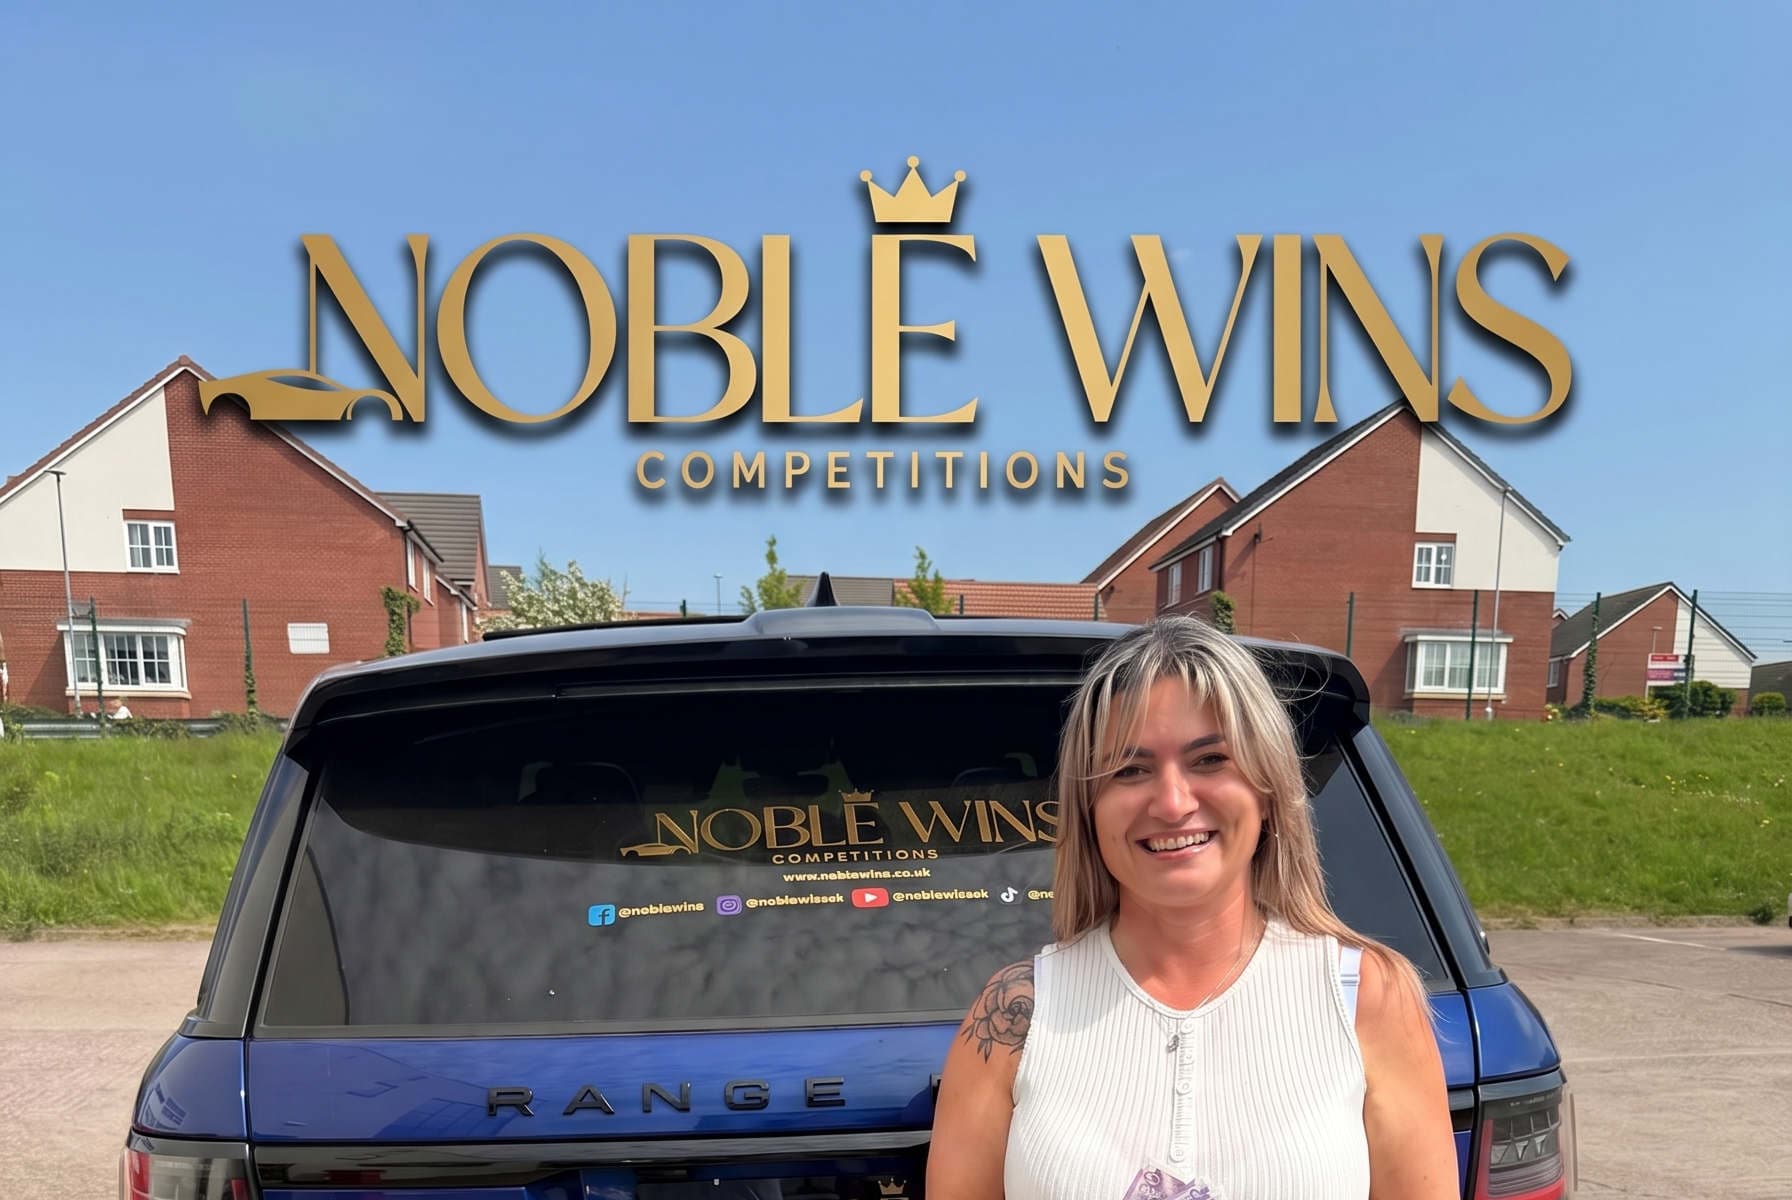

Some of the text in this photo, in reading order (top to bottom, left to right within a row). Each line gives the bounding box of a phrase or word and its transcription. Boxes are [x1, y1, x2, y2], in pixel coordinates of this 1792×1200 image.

[655, 803, 885, 855] NOBLE
[771, 849, 939, 865] COMPETITIONS
[487, 1076, 846, 1117] RANGE
